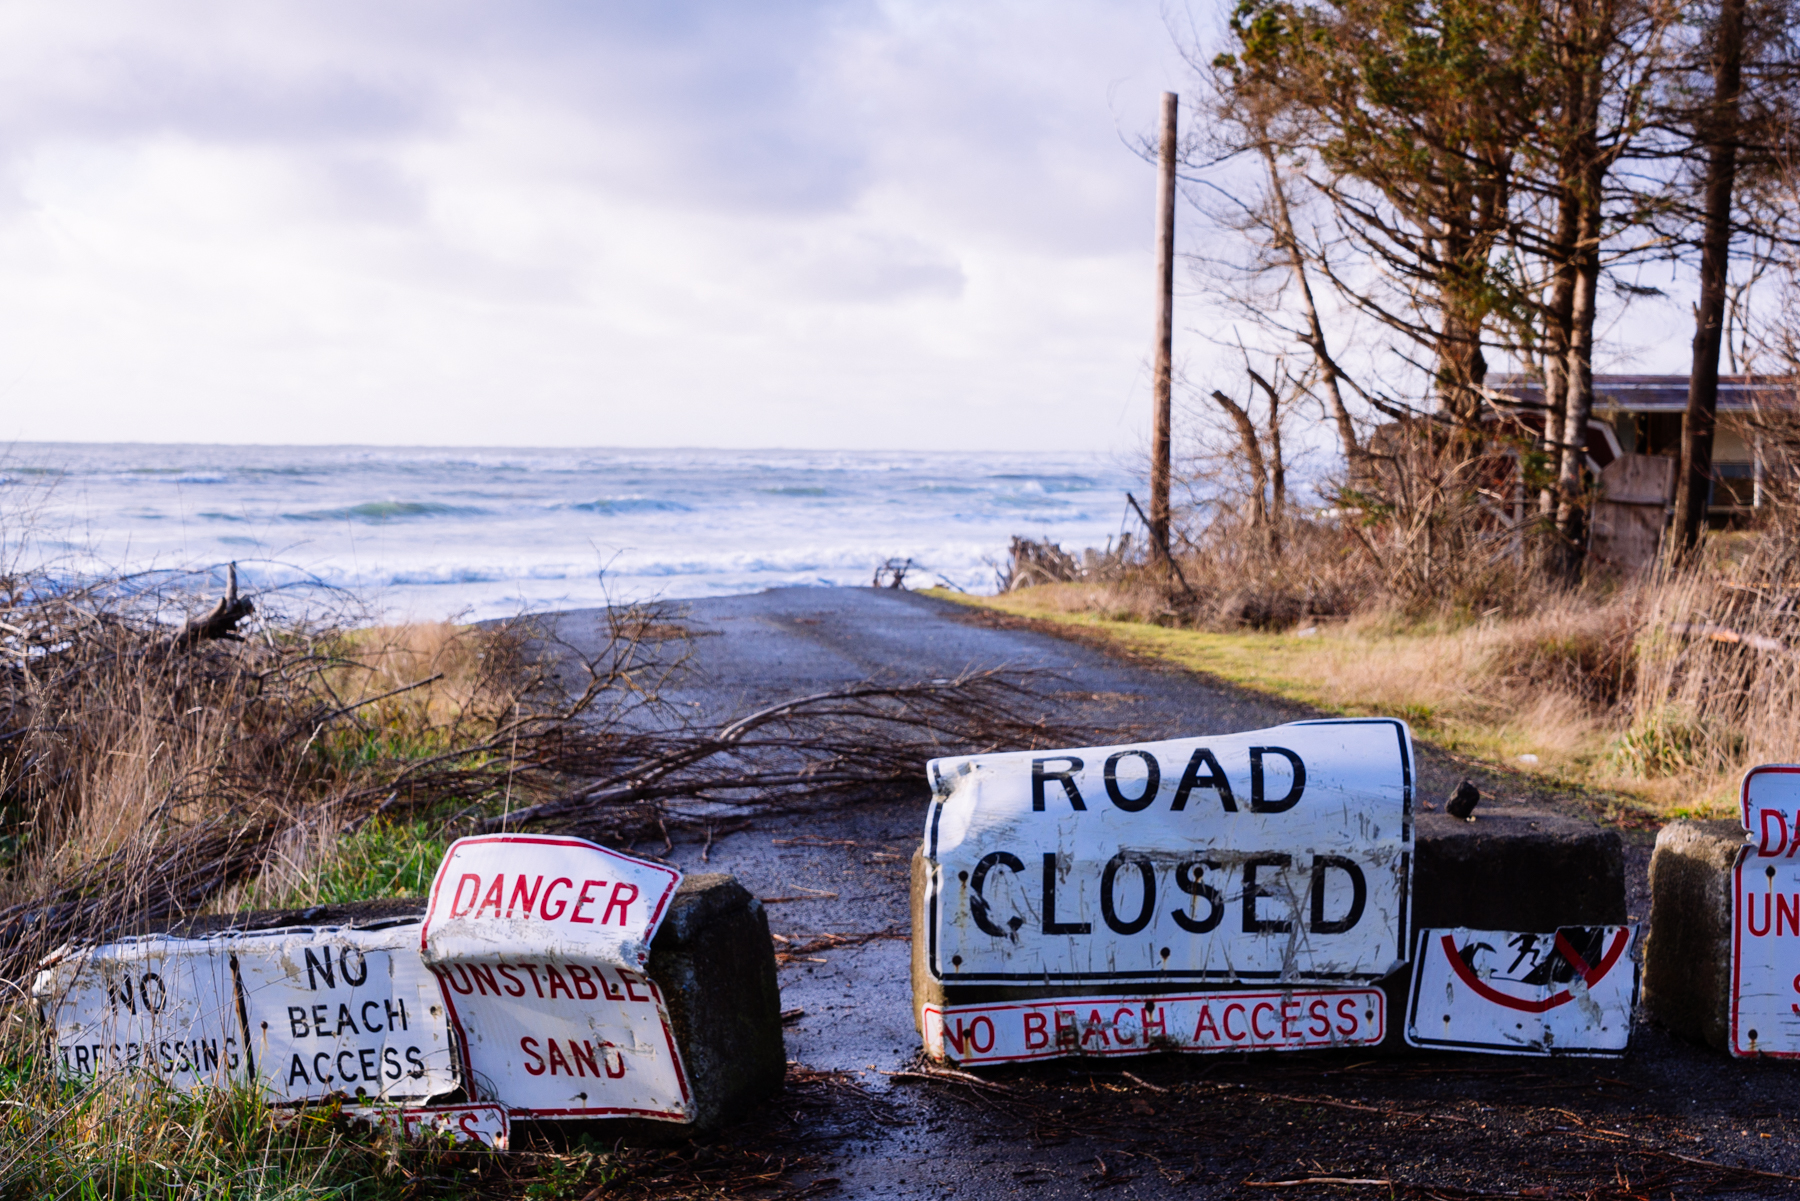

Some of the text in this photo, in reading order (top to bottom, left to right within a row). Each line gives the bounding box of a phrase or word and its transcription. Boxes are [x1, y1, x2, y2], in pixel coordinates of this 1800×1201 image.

[1031, 746, 1307, 814] ROAD
[449, 873, 639, 927] DANGER
[969, 851, 1367, 936] CLOSED
[305, 946, 367, 991] NO
[439, 963, 650, 1003] UNSTABLE
[107, 973, 166, 1015] NO
[288, 998, 407, 1038] BEACH
[940, 999, 1359, 1054] NO BEACH ACCESS
[289, 1046, 425, 1087] ACCESS
[520, 1036, 626, 1079] SAND
